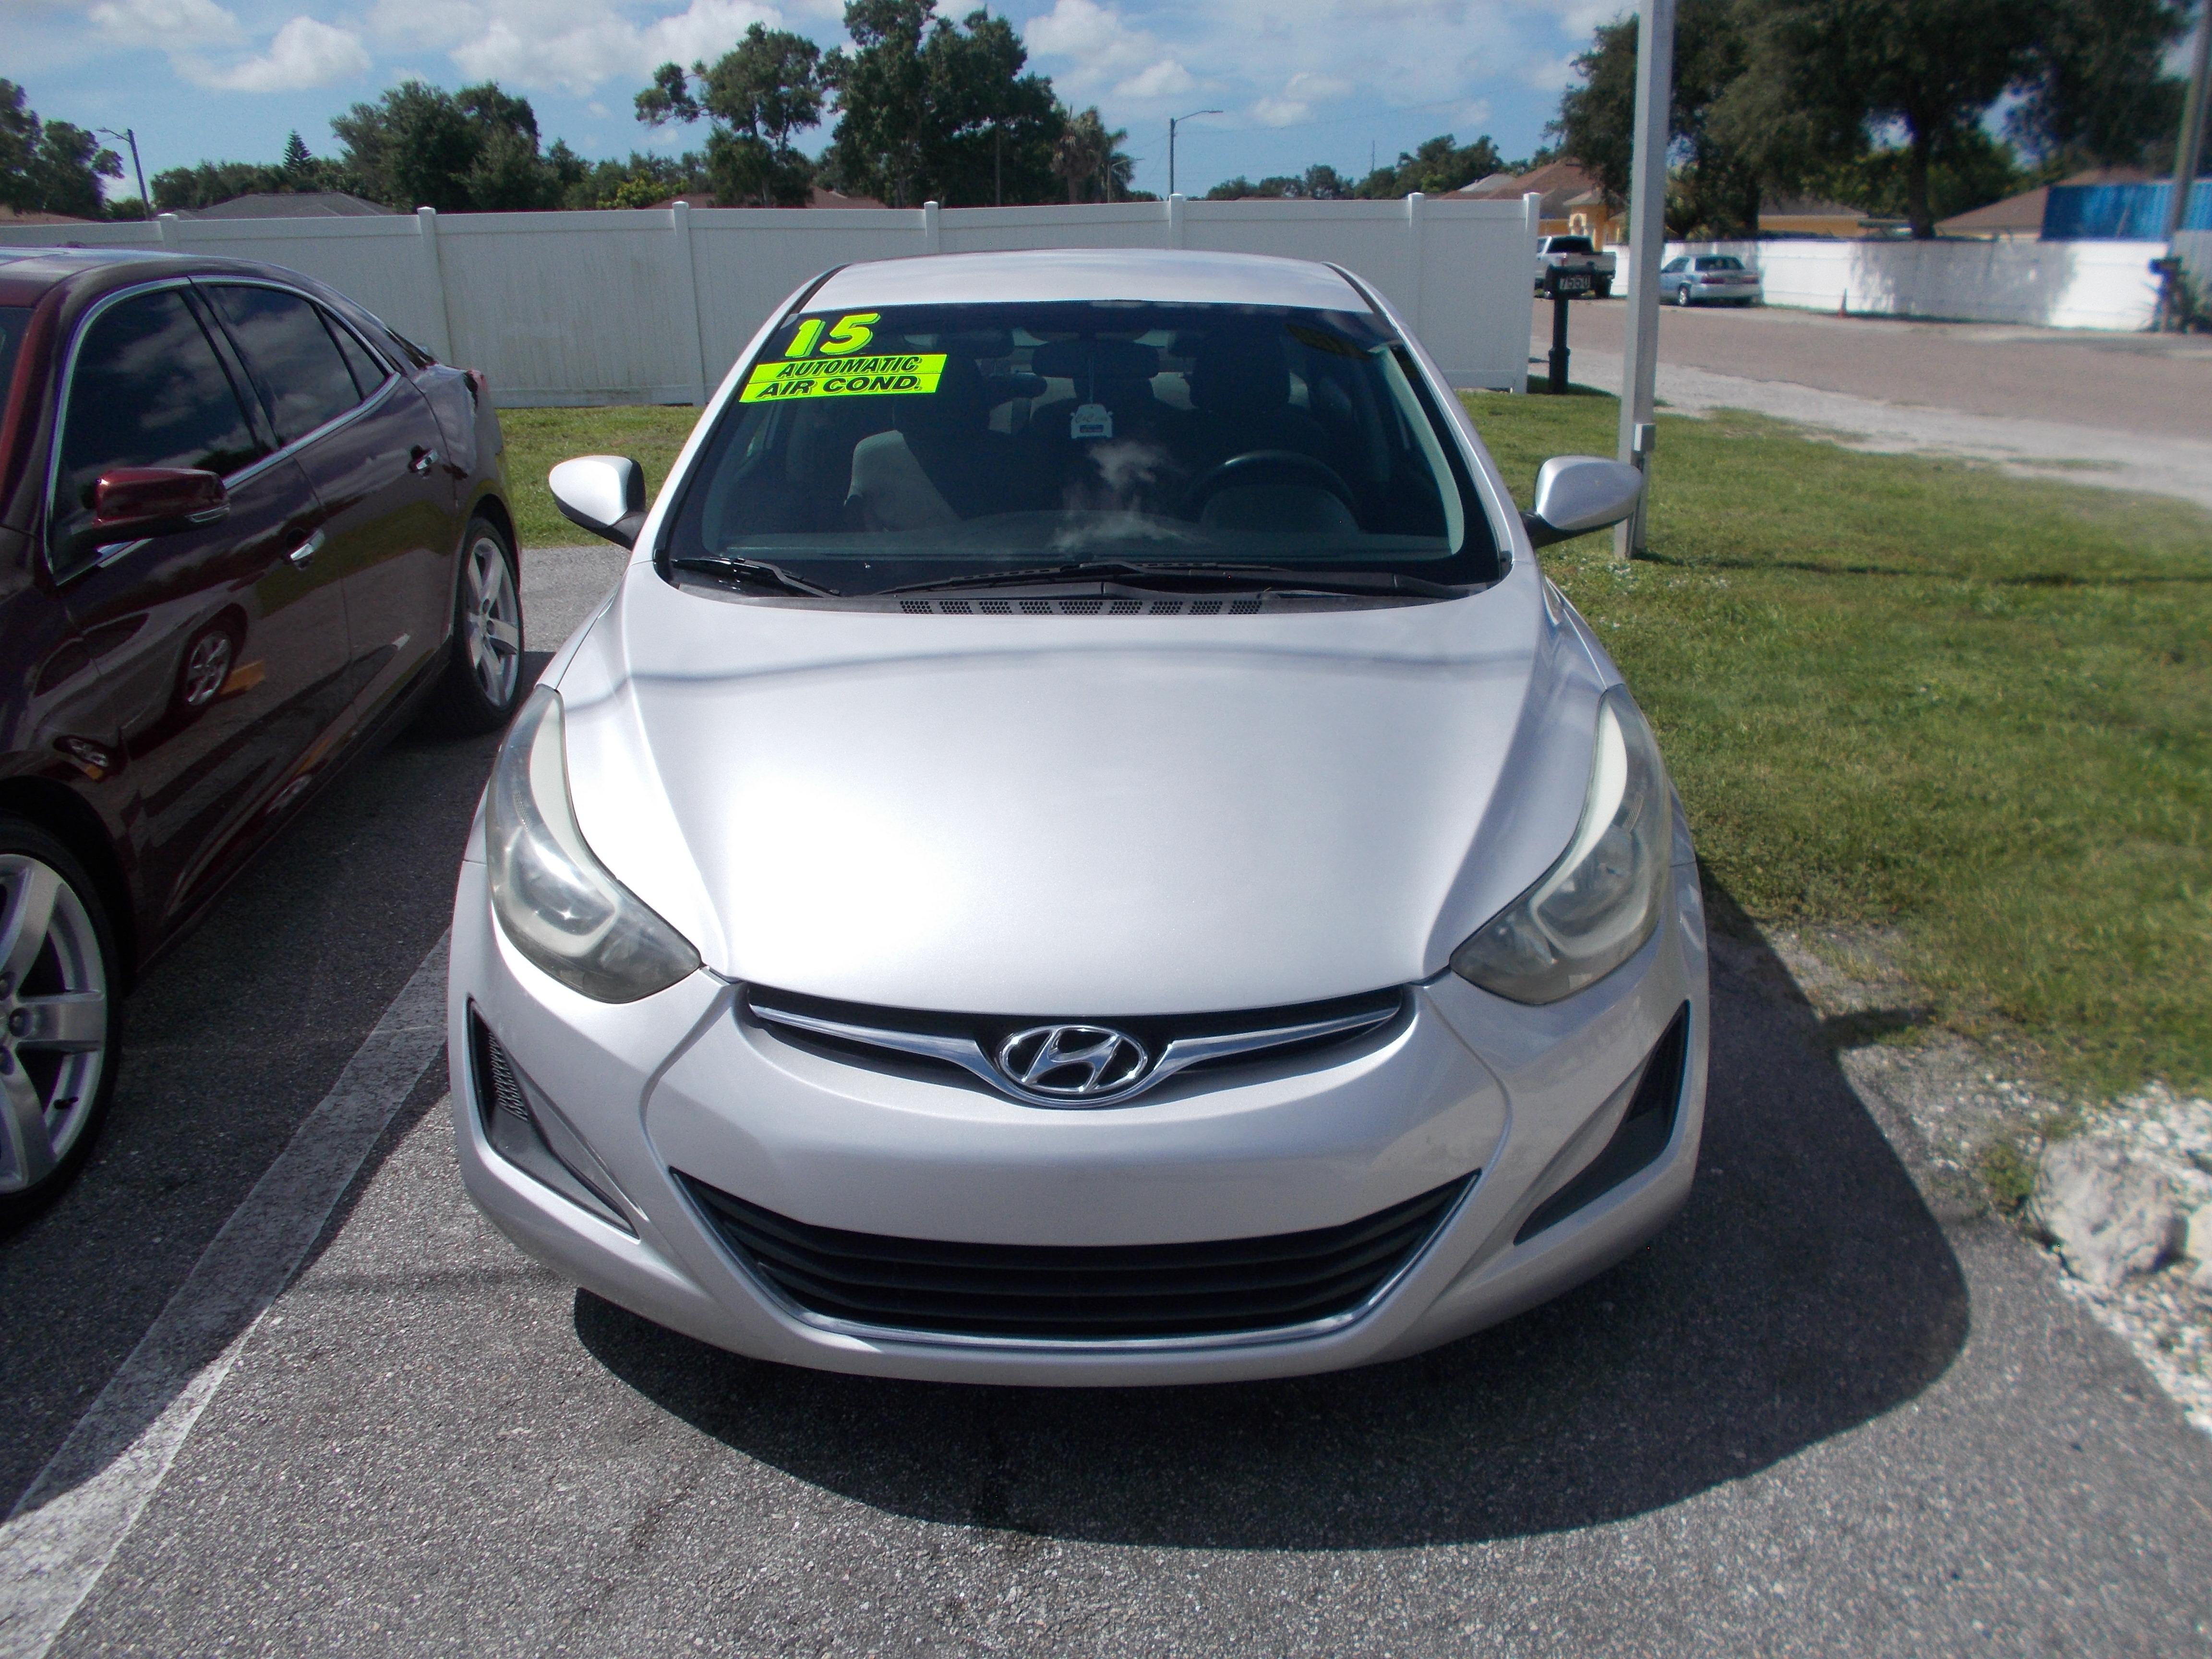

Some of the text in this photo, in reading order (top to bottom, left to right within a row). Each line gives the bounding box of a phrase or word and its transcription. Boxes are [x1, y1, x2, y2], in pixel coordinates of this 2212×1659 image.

[785, 313, 881, 358] 15
[776, 357, 922, 378] AUTOMATIC
[757, 375, 922, 398] AIR COND.
